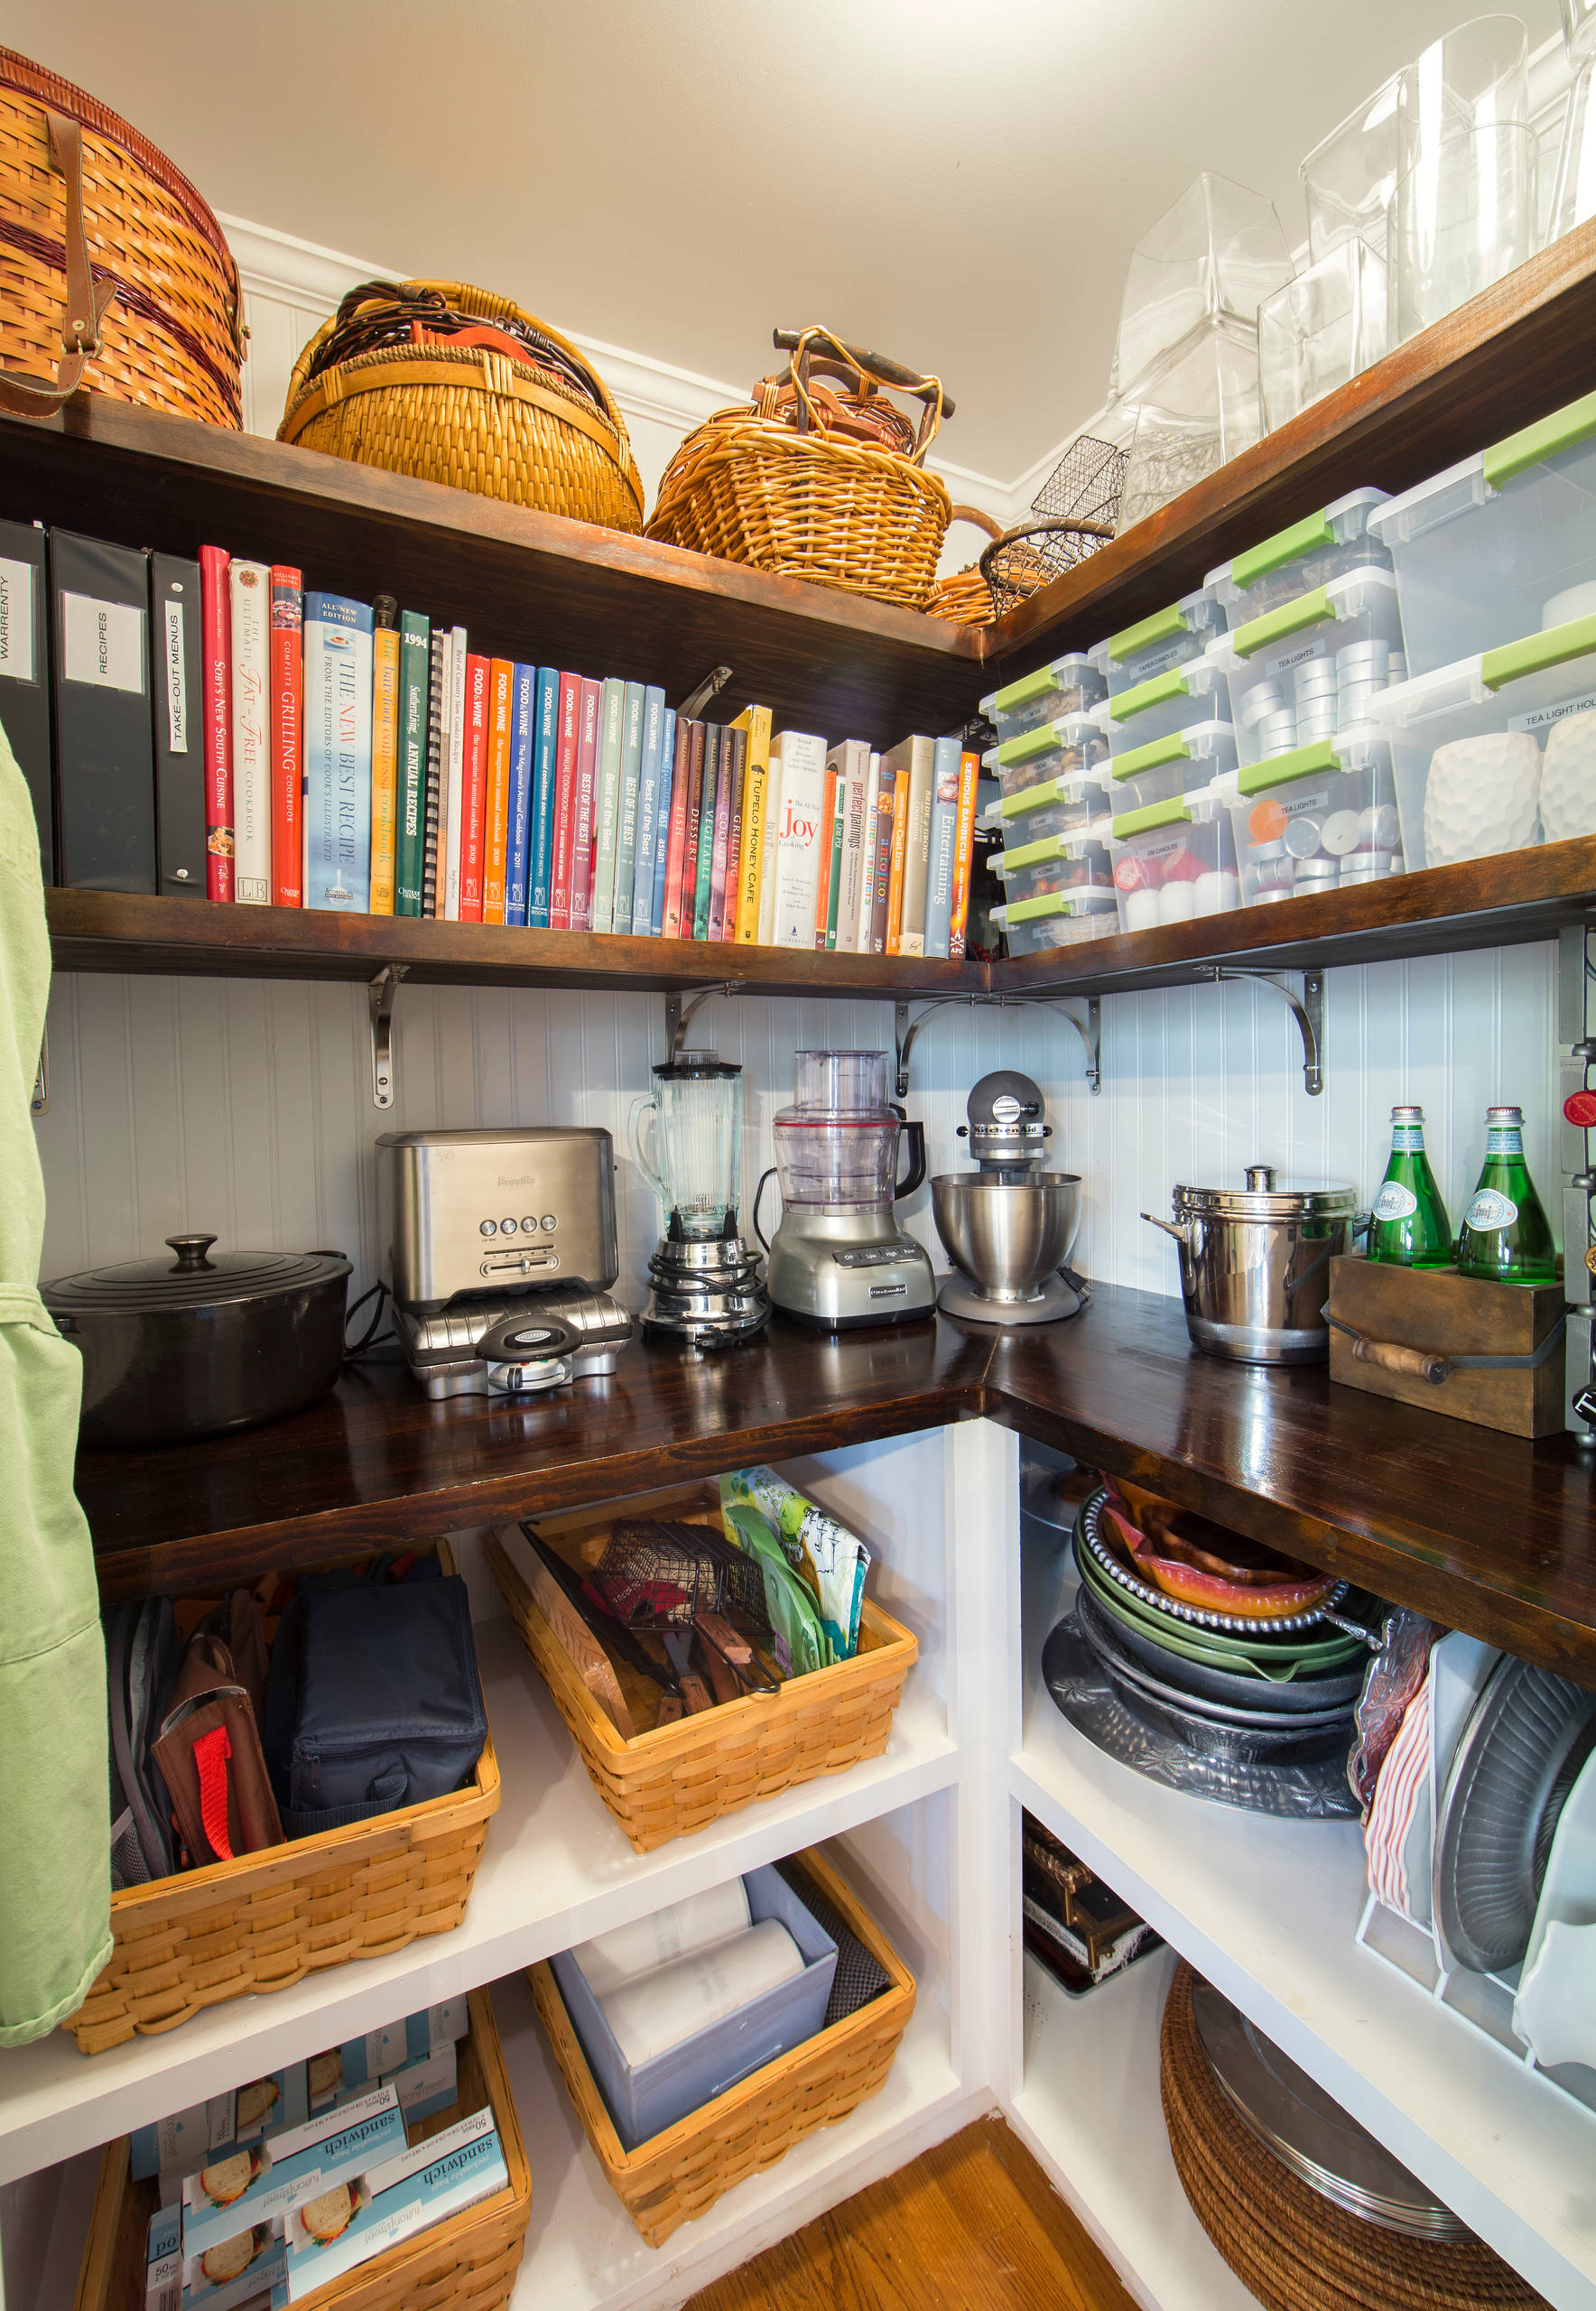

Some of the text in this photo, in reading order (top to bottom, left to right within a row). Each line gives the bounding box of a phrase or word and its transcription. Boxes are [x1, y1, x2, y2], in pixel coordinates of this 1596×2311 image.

[321, 603, 357, 616] ALL-NEW
[322, 610, 357, 624] EDITION
[98, 612, 107, 674] RECIPES
[243, 599, 252, 661] ULTIMATE
[404, 633, 427, 649] 1994
[1138, 649, 1178, 673] TAPER CANDLES
[1278, 647, 1314, 669] TEA LIGHTS
[170, 615, 182, 741] TAKE-OUT MENUS
[382, 665, 395, 724] barefoot
[472, 667, 483, 728] FOOD&WINE
[496, 673, 507, 732] FOOD&WINE
[519, 678, 530, 737] FOOD&WINE
[543, 687, 553, 737] FOOD&WINE
[608, 694, 618, 745] FOOD&WINE
[648, 702, 658, 752] FOOD&WINE
[1526, 714, 1544, 726] TEA
[1545, 704, 1575, 719] LIGHT
[214, 660, 227, 810] SOBY'S NEW SOUTH CUISINE
[282, 641, 296, 822] COMPLETE GRILLING COOKBOOK
[473, 734, 481, 743] the
[323, 655, 332, 862] FROM THE EDITORS OF COOK'S ILLUSTRATED
[339, 661, 355, 865] THE NEW BEST RECIPE
[381, 729, 392, 791] contessa
[471, 745, 480, 780] magazine's
[518, 744, 526, 756] The
[560, 689, 574, 828] FOOD&WINE ANNUAL COOKBOOK 2013
[578, 694, 595, 844] FOOD&WINE BEST OF THE BEST
[961, 761, 973, 806] SERIOUS
[406, 740, 419, 837] ANNUAL RECIPES
[495, 787, 503, 812] annual
[605, 773, 615, 797] Best
[625, 777, 636, 795] BEST
[645, 779, 654, 802] Best
[851, 781, 865, 814] perfect
[245, 771, 254, 843] COOKBOOK
[515, 790, 524, 812] Annual
[604, 798, 613, 810] of
[624, 809, 634, 824] THE
[625, 796, 635, 808] OF
[643, 803, 652, 814] of
[1281, 798, 1317, 814] TEA LIGHTS
[379, 794, 392, 863] cookbook
[469, 809, 478, 840] cookbook
[493, 812, 502, 844] cookbook
[515, 813, 524, 845] Cookbook
[603, 811, 612, 826] the
[642, 815, 652, 831] the
[674, 806, 684, 836] FISH
[848, 813, 864, 849] pairings
[921, 790, 932, 862] BRIDE GROOM
[1035, 817, 1046, 825] SAND
[602, 829, 612, 851] Best
[623, 826, 633, 847] BEST
[641, 833, 651, 856] Best
[688, 808, 700, 863] DESSERT
[701, 810, 714, 881] VEGETABLE
[716, 812, 728, 869] COOKIES
[729, 814, 741, 877] GRILLING
[747, 778, 763, 904] TUPELO HONEY CAFE
[778, 839, 804, 850] Cooking
[895, 829, 904, 849] Cast
[959, 808, 970, 862] BARBECUE
[1155, 842, 1178, 855] CANDLES
[469, 845, 477, 864] 2009
[493, 847, 501, 866] 2010
[514, 851, 522, 868] 2011
[657, 839, 666, 863] asian
[895, 850, 903, 871] Iron
[933, 814, 954, 905] Entertaining
[875, 838, 889, 904] antojitos
[974, 1125, 1037, 1134] KitchenAid
[378, 2093, 391, 2105] 50
[324, 2111, 395, 2156] sandwich
[475, 2118, 487, 2130] 50
[422, 2138, 494, 2185] sandwich
[155, 2263, 169, 2277] 50
